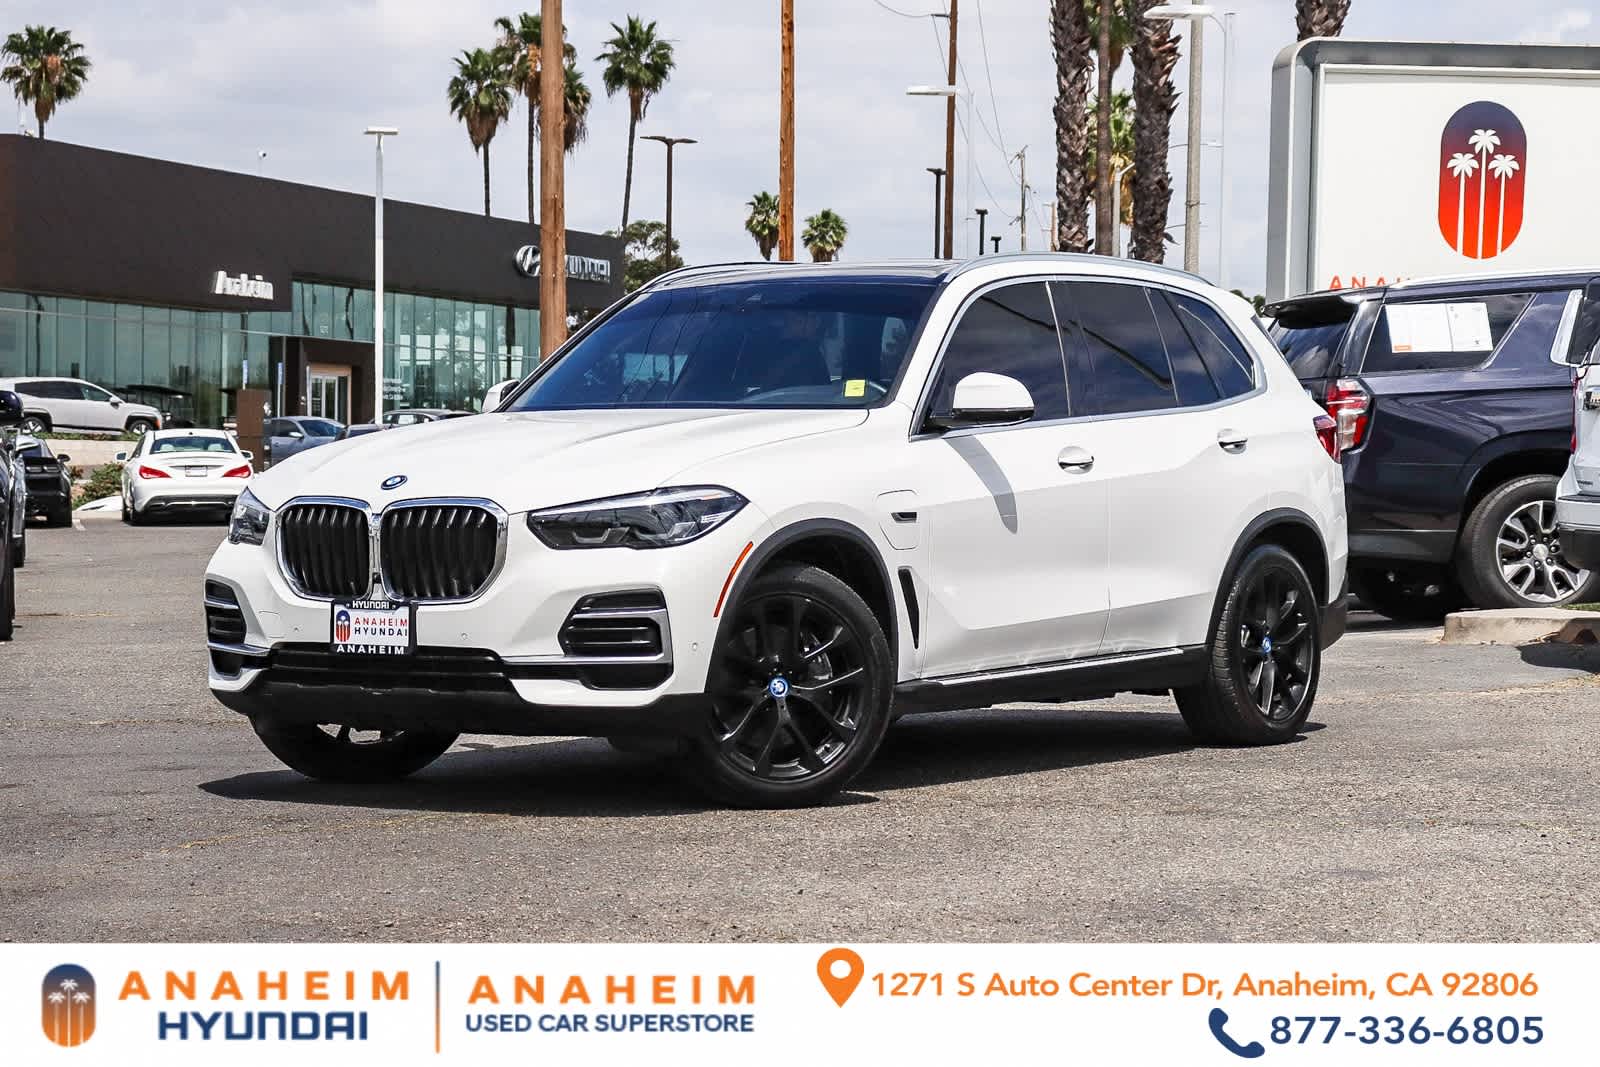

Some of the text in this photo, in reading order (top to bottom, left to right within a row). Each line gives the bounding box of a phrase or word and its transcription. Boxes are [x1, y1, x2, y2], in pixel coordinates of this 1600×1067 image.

[352, 600, 390, 609] HYUNDAI
[354, 617, 408, 627] ANAHEIM
[354, 627, 408, 636] HYUNDAI
[336, 644, 405, 655] ANAHEIM
